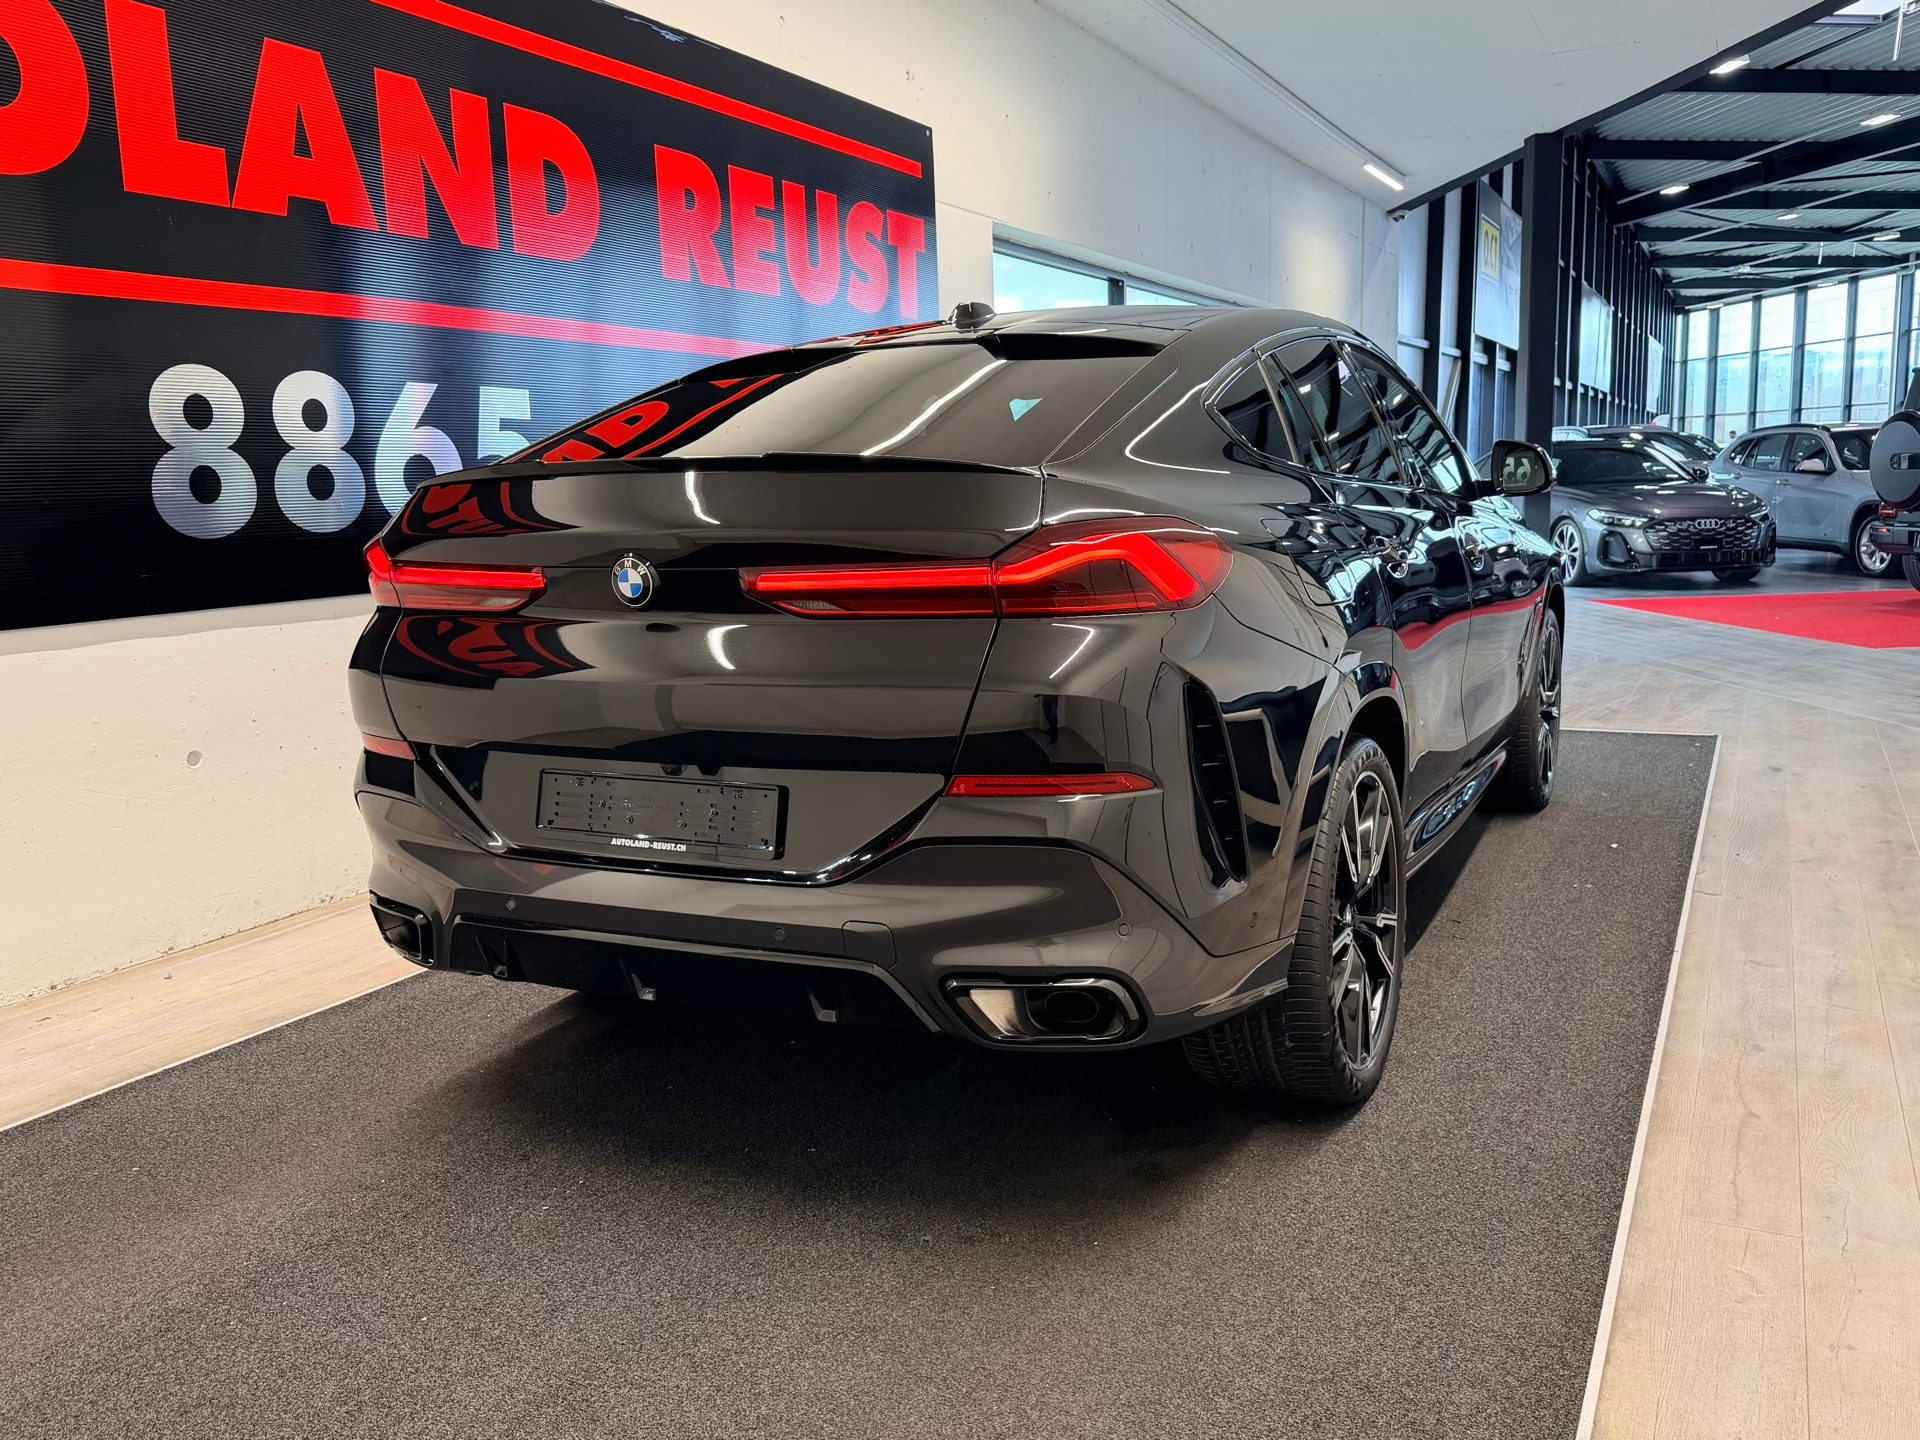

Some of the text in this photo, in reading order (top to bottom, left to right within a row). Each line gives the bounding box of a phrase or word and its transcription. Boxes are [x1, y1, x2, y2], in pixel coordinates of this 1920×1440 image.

[654, 144, 925, 319] REUST
[613, 559, 647, 576] BMW
[611, 838, 686, 852] AUTOLAND-REUST.CH
